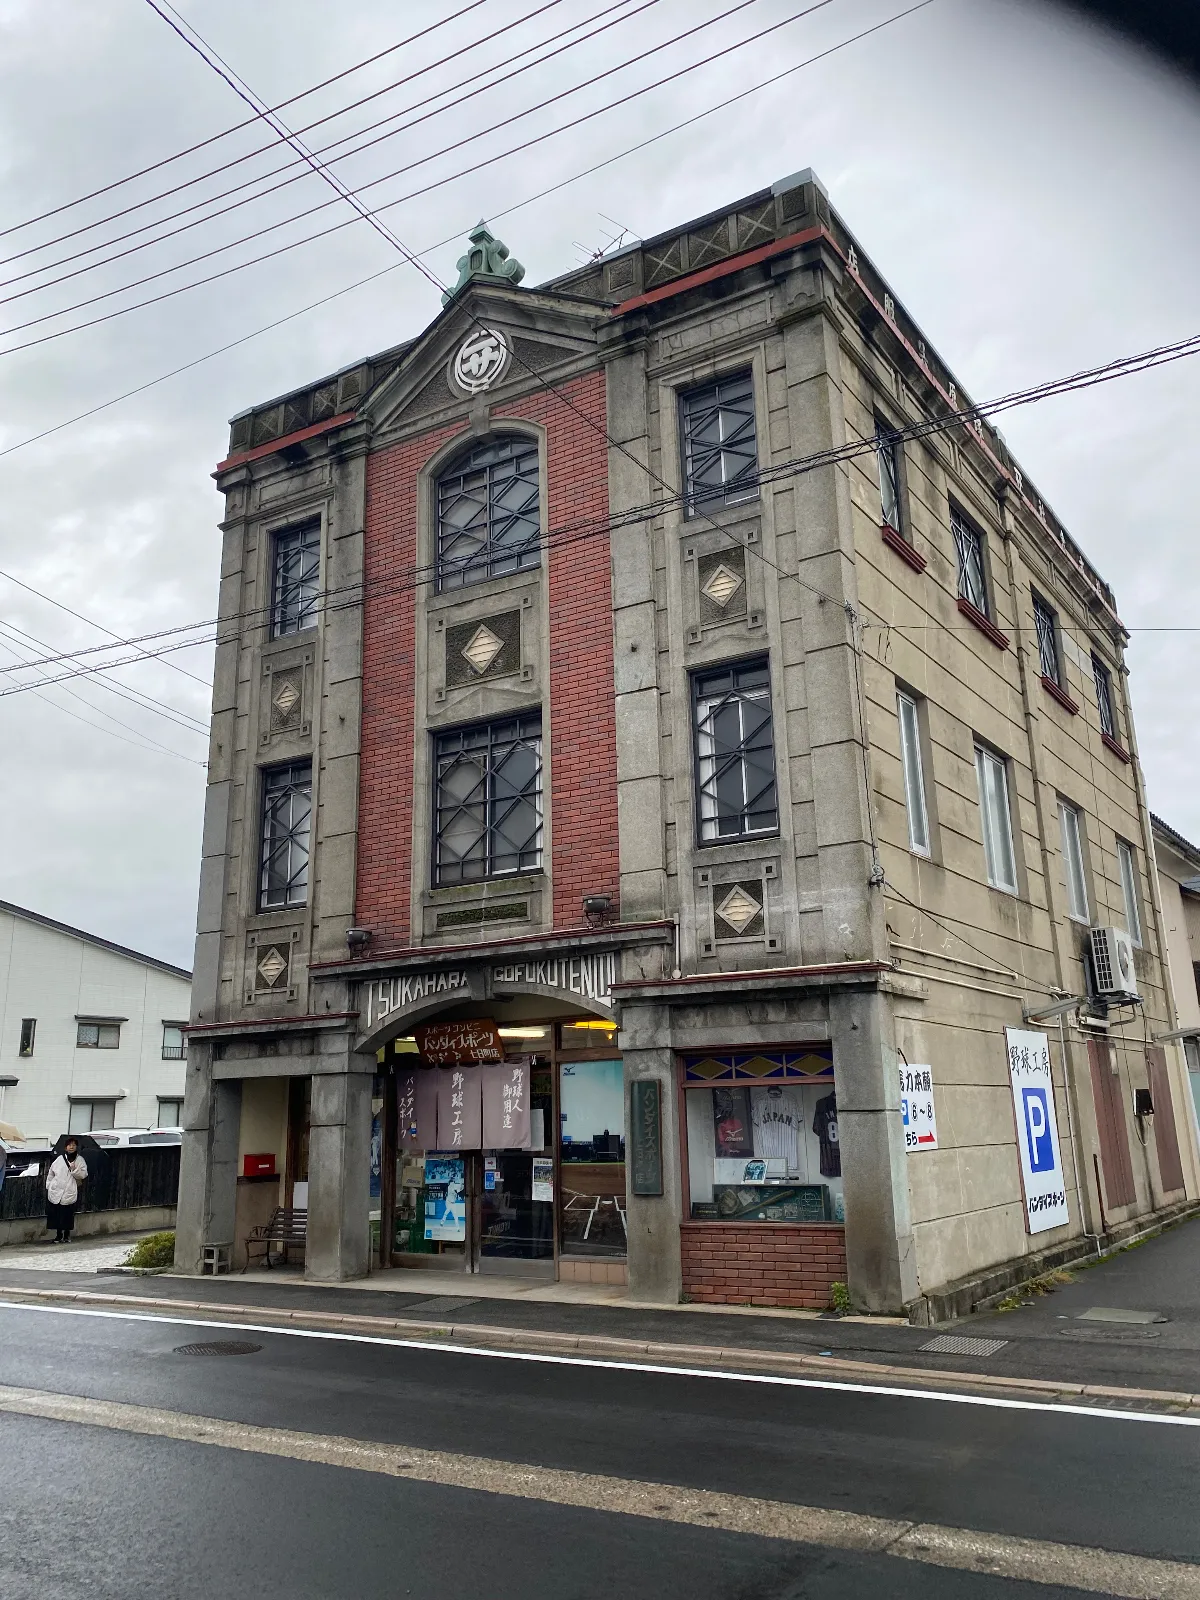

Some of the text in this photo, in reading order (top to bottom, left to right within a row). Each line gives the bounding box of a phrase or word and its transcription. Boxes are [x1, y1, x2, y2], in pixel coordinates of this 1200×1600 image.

[364, 970, 468, 1028] TSUKAHARA
[1010, 1045, 1049, 1077] 野球工房
[451, 1071, 464, 1145] 野球工房
[502, 1083, 513, 1129] 御用達
[511, 1068, 524, 1112] 野球人
[762, 1111, 792, 1126] JAPAN
[1026, 1095, 1046, 1165] P
